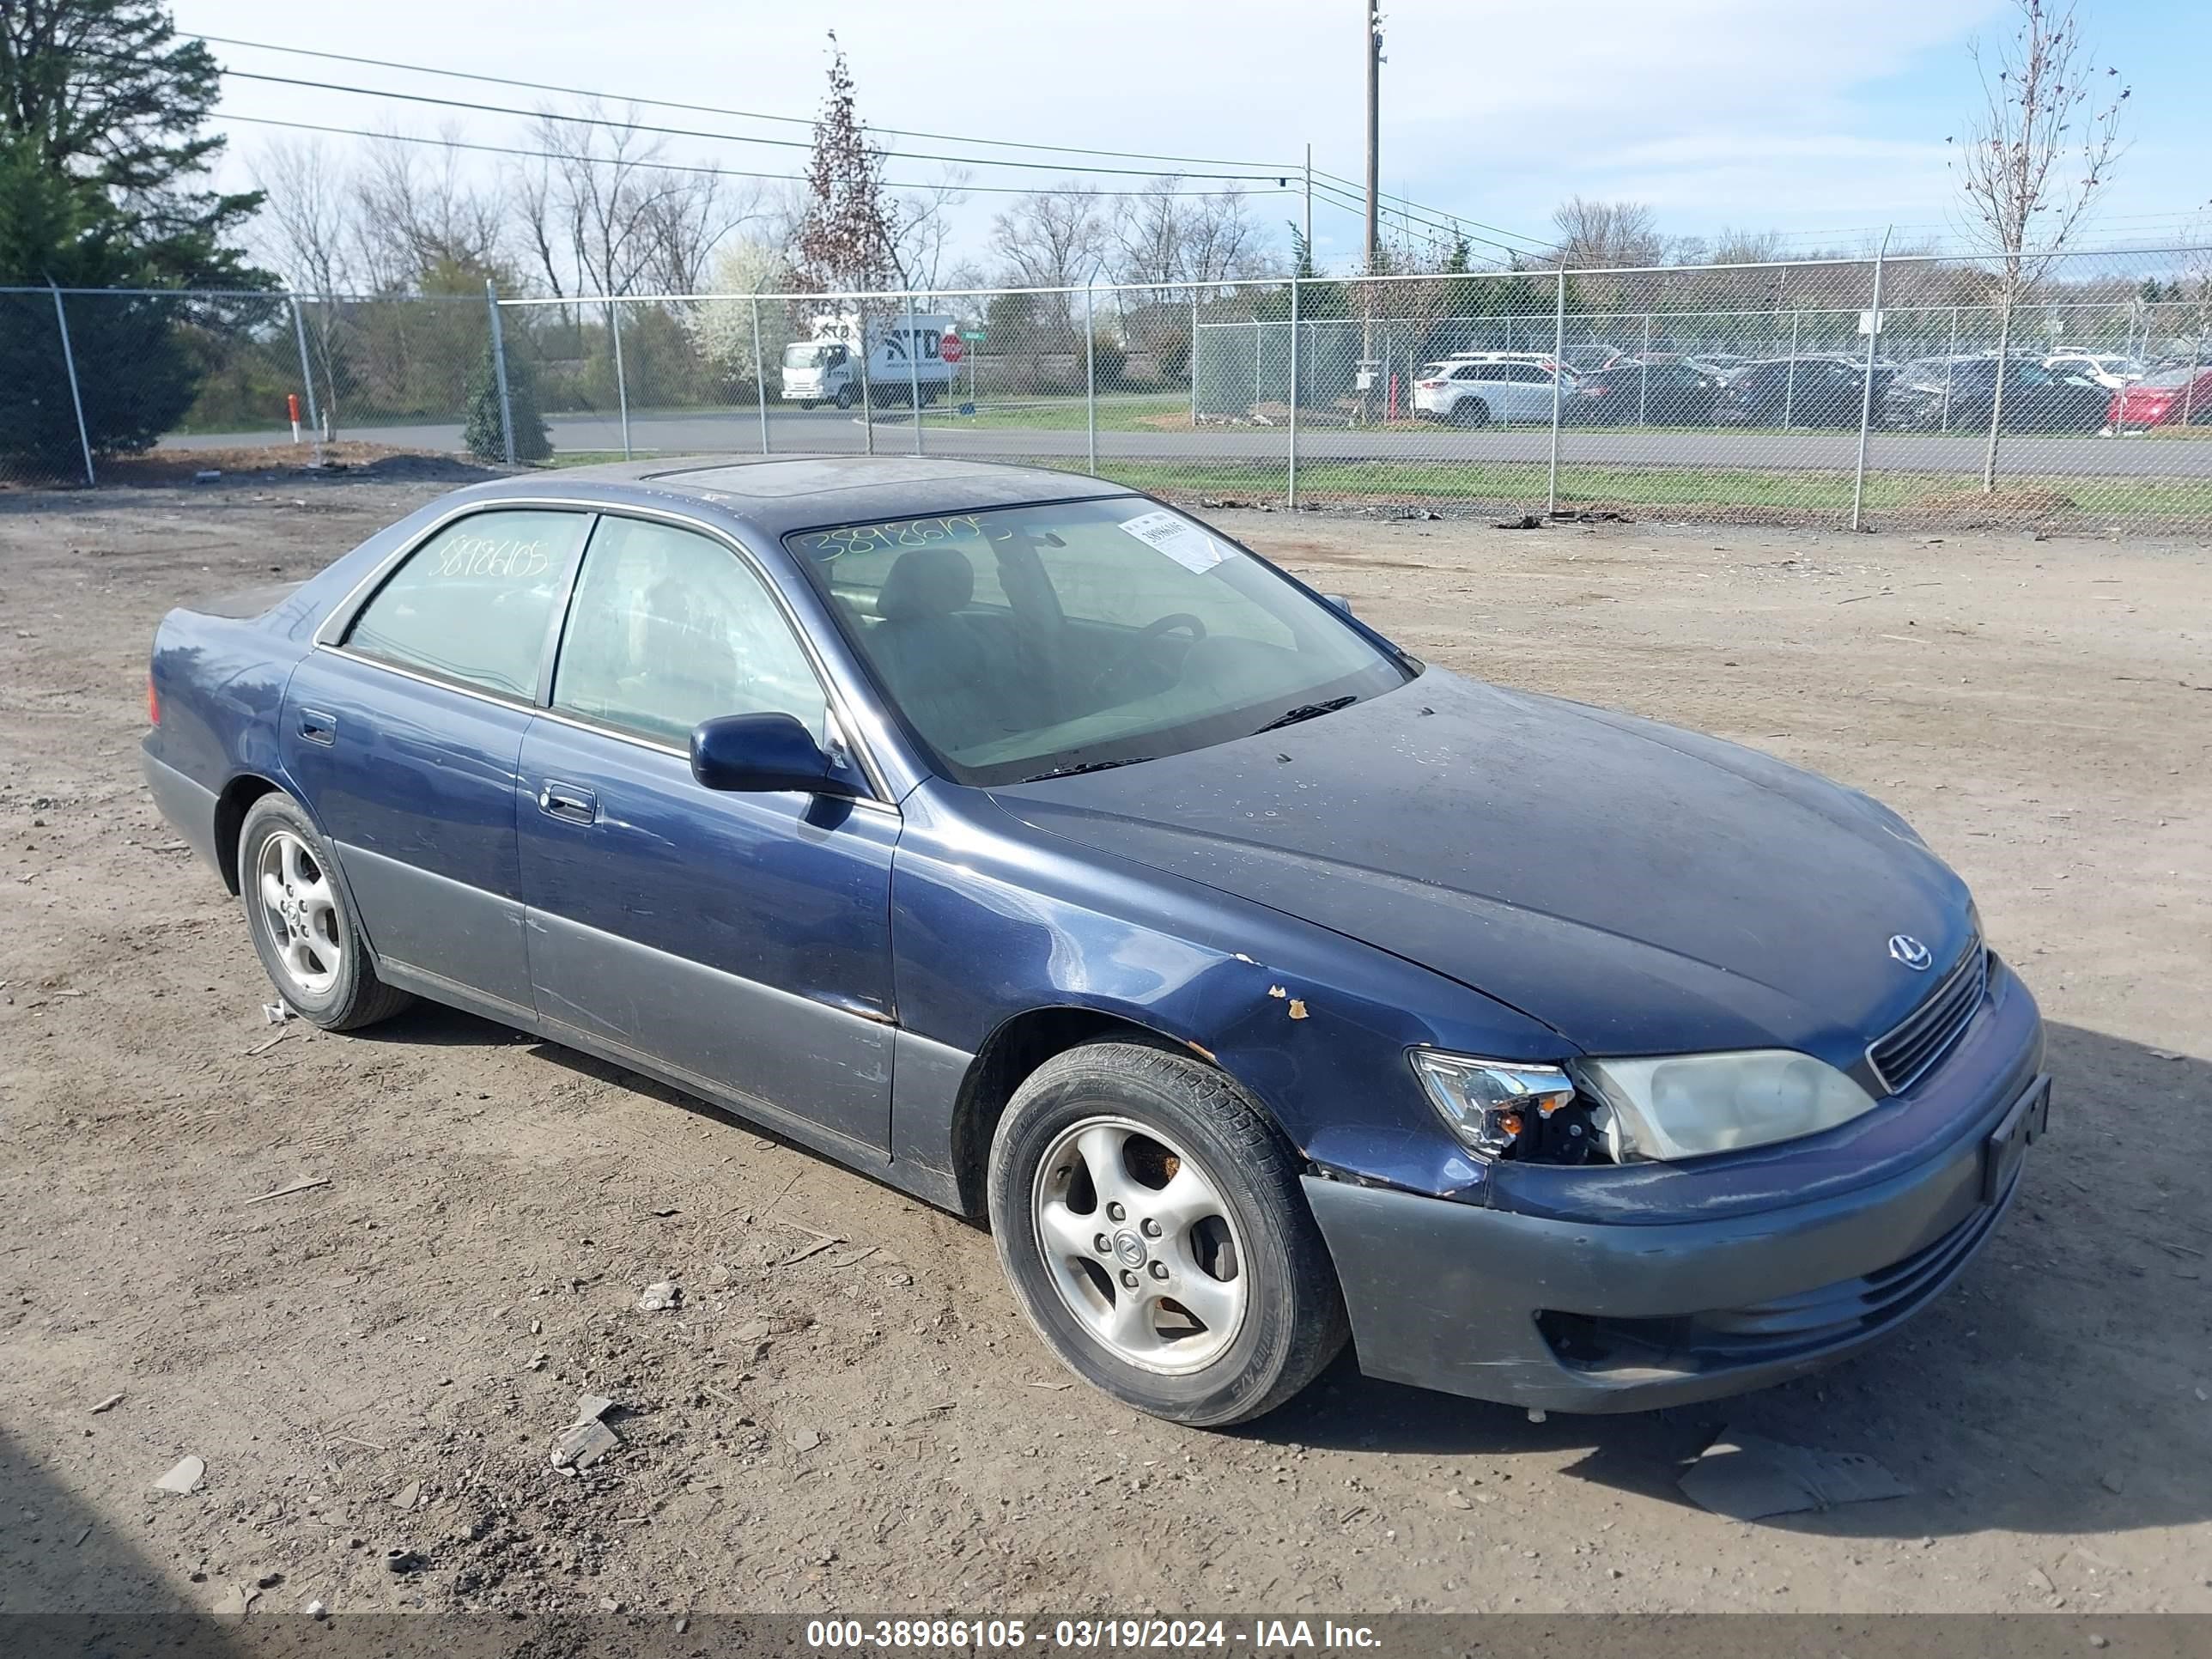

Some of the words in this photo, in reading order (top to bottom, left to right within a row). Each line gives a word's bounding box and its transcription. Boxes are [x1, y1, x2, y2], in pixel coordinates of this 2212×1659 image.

[941, 343, 963, 355] STOP
[1141, 521, 1187, 543] 38986105
[1014, 1107, 1038, 1141] SILVER
